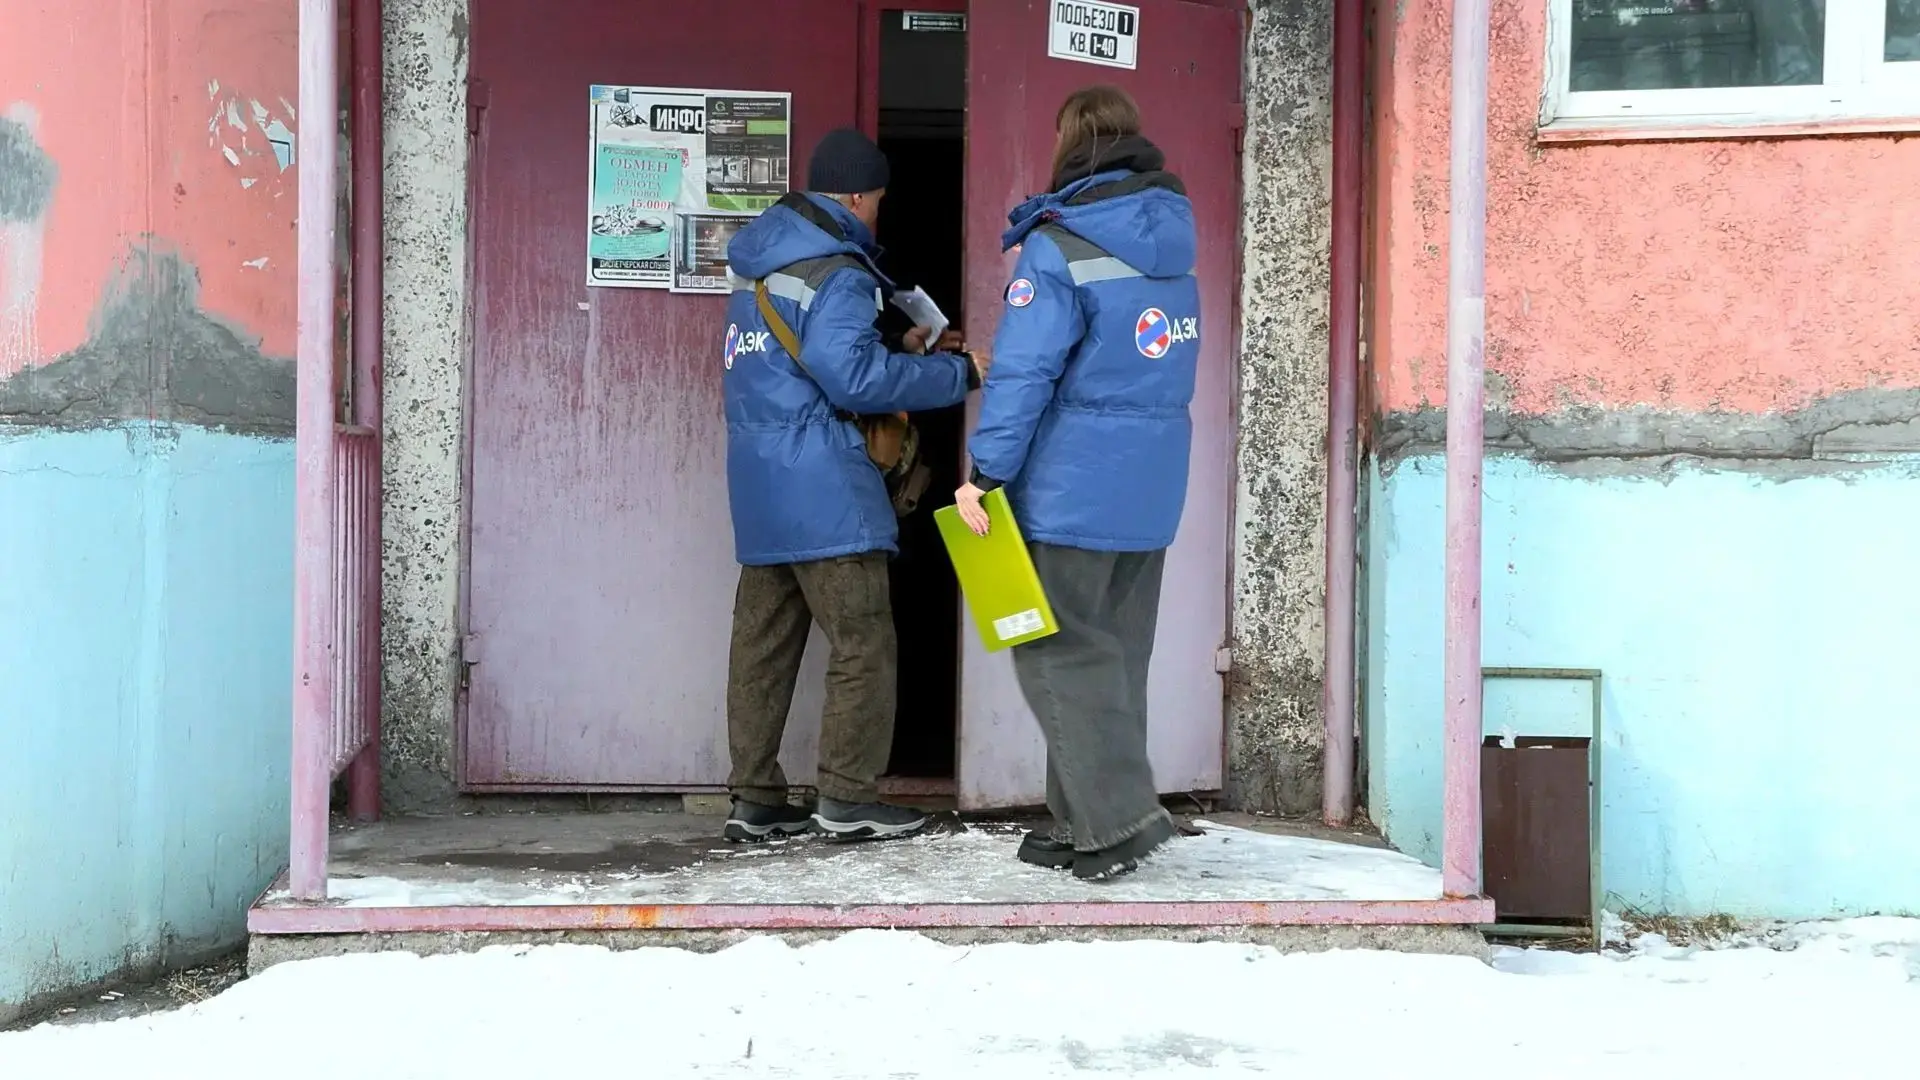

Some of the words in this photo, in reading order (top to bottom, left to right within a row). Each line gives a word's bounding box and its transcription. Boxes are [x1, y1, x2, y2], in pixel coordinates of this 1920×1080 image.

[1056, 2, 1115, 31] ПОДЪЕЗД
[1093, 36, 1115, 57] 1-40
[656, 108, 705, 132] ИНФО
[610, 157, 668, 172] ОБМЕН
[616, 178, 663, 190] ЗОЛОТА
[600, 260, 648, 269] ДИСПЕТЧЕРСКАЯ
[1171, 316, 1198, 344] ДЭК
[735, 331, 770, 355] ДЭК
